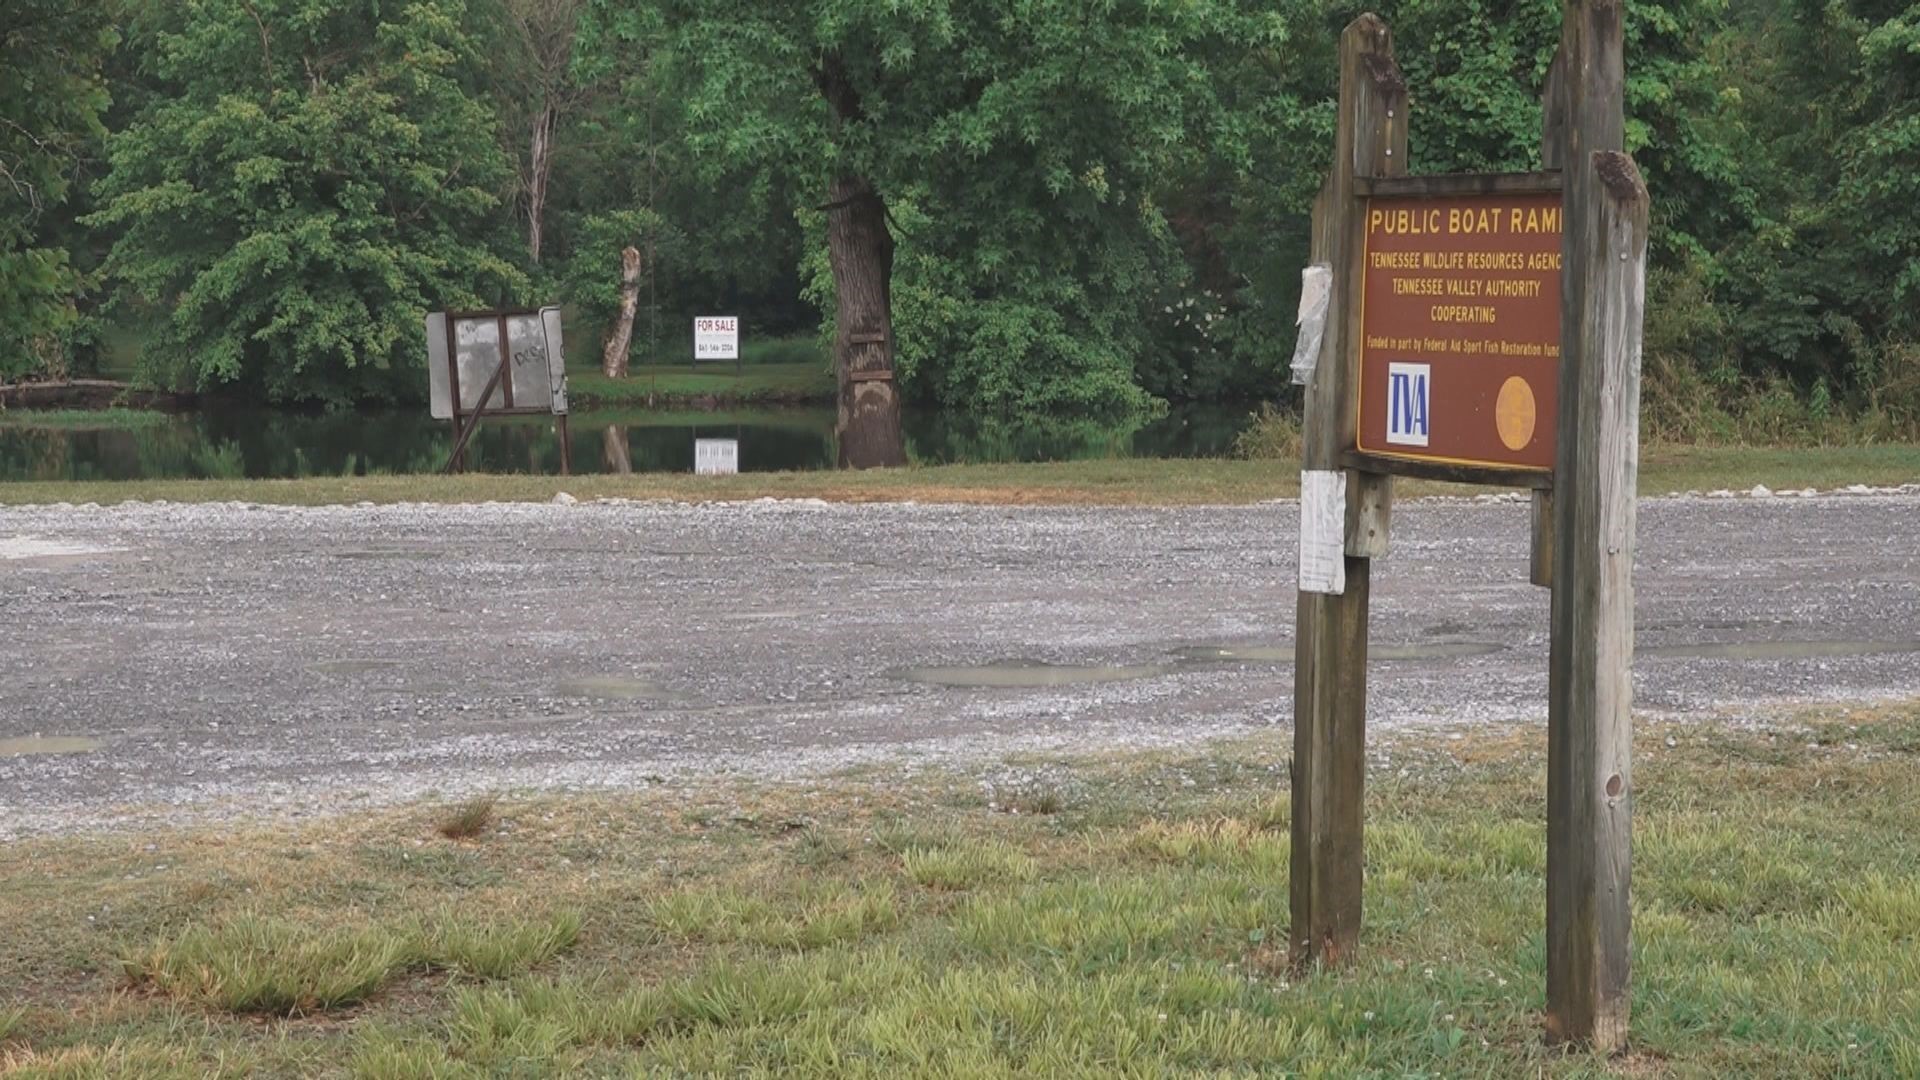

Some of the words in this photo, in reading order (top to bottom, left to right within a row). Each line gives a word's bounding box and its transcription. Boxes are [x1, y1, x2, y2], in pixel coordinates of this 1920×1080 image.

[1371, 209, 1441, 234] PUBLIC
[1448, 208, 1502, 233] BOAT
[1510, 207, 1563, 233] RAM
[1370, 252, 1420, 269] TENNESSEE
[1423, 252, 1464, 269] WILDLIFE
[1467, 252, 1524, 269] RESOURCES
[1527, 253, 1562, 270] AGENC
[1393, 278, 1443, 295] TENNESSEE
[1446, 279, 1482, 296] VALLEY
[1485, 280, 1541, 297] AUTHORITY
[1431, 305, 1496, 323] COOPERATING
[697, 320, 713, 331] FOR
[714, 320, 735, 331] SALE
[1367, 335, 1389, 349] Funded
[1390, 337, 1397, 349] in
[1398, 338, 1412, 351] part
[1413, 338, 1421, 353] by
[1424, 337, 1447, 352] Federal
[1450, 338, 1461, 352] Aid
[1463, 339, 1482, 354] Sport
[1484, 340, 1499, 353] Fish
[1501, 340, 1542, 356] Restoration
[1391, 373, 1427, 435] TVA
